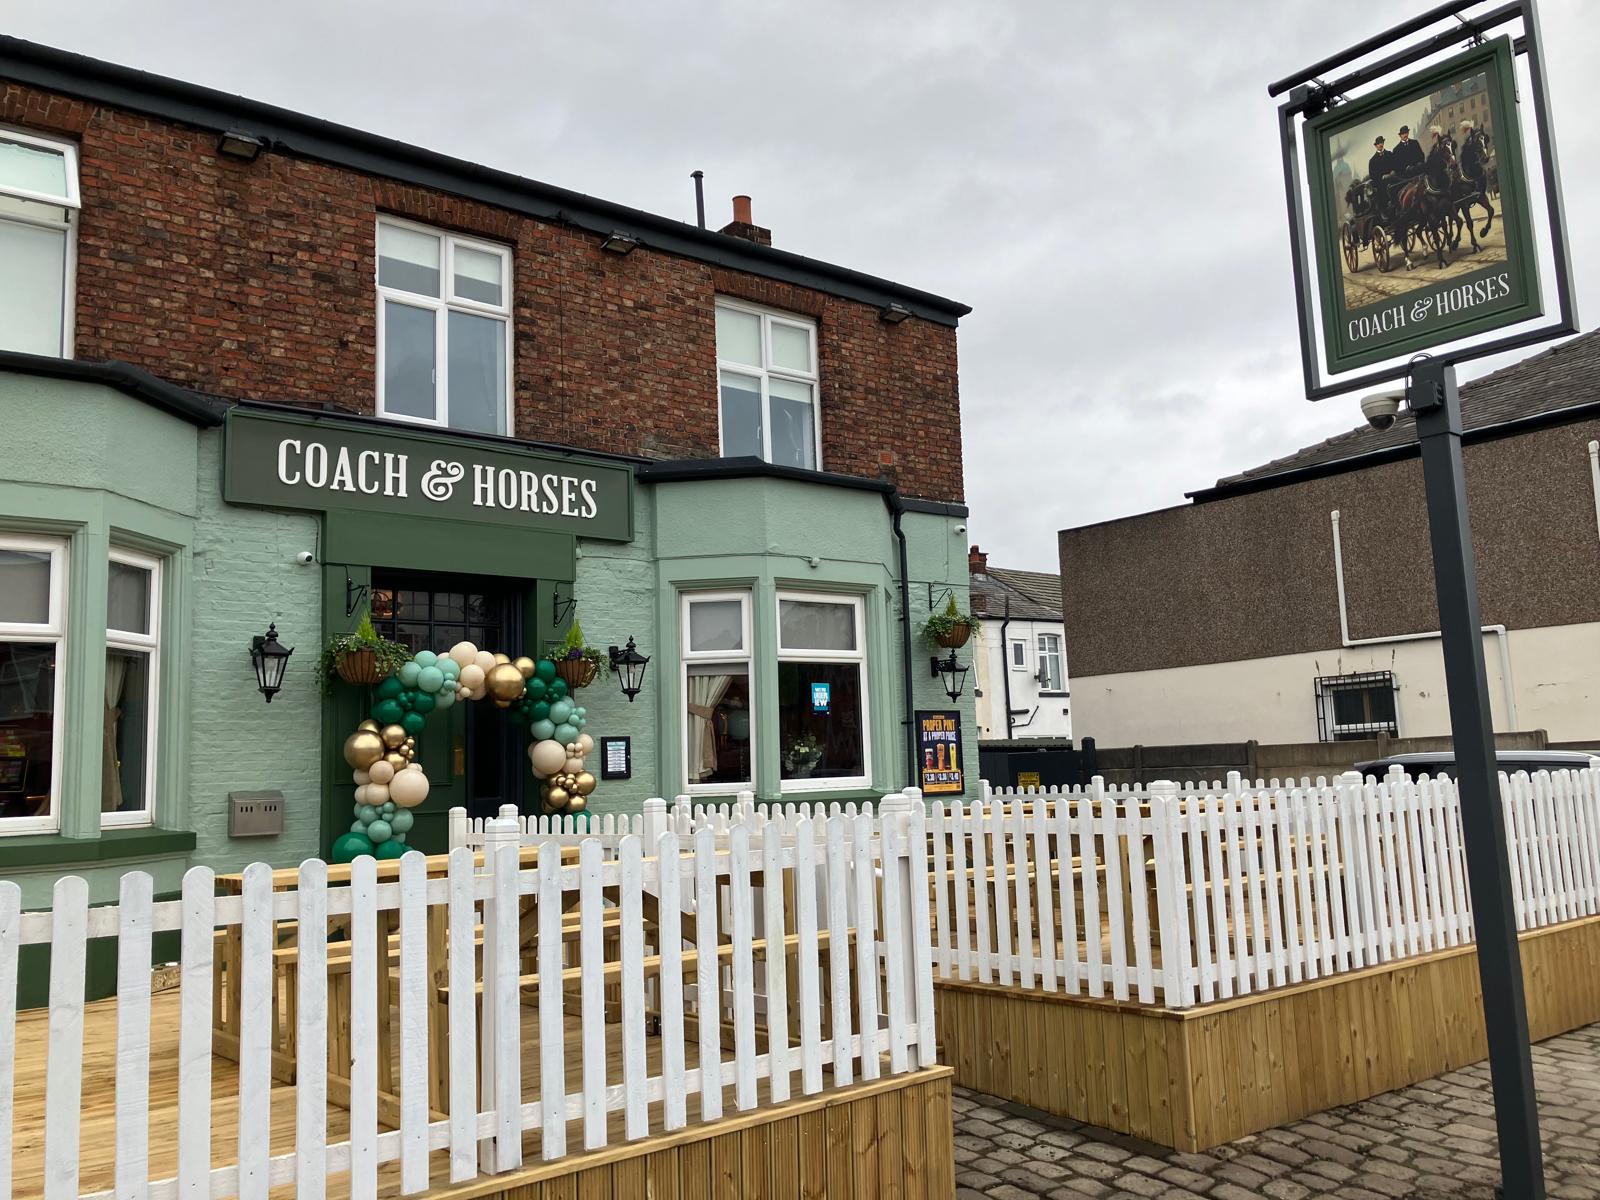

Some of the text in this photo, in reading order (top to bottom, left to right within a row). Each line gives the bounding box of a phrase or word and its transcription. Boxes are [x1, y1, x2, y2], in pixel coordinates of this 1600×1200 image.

[1348, 273, 1510, 341] COACH & HORSES
[277, 438, 597, 519] COACH & HORSES
